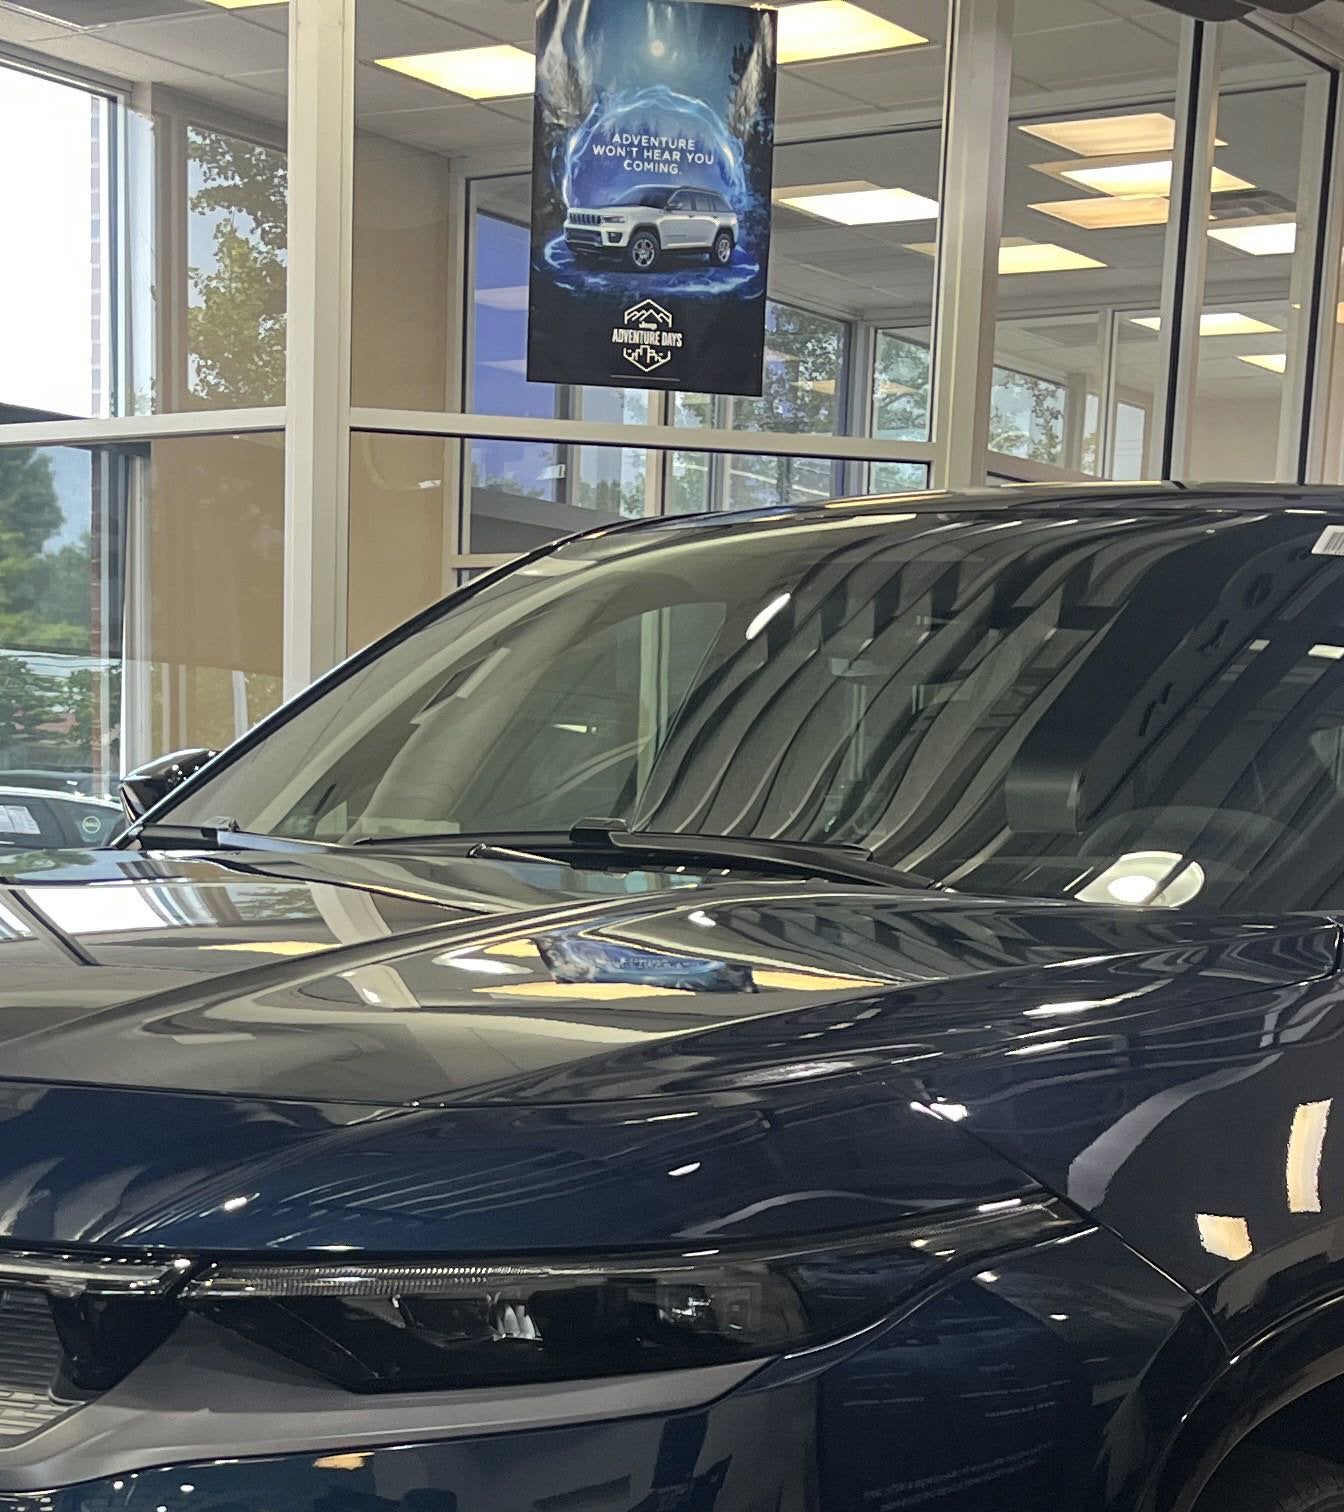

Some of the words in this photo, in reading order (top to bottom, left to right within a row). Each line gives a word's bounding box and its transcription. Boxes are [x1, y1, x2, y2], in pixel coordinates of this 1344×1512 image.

[612, 134, 696, 150] ADVENTURE
[592, 144, 639, 158] WON'T
[643, 149, 681, 162] HEAR
[686, 152, 714, 165] YOU
[623, 160, 682, 175] COMING.
[611, 328, 660, 346] ADVENTURE
[661, 331, 683, 348] DAYS
